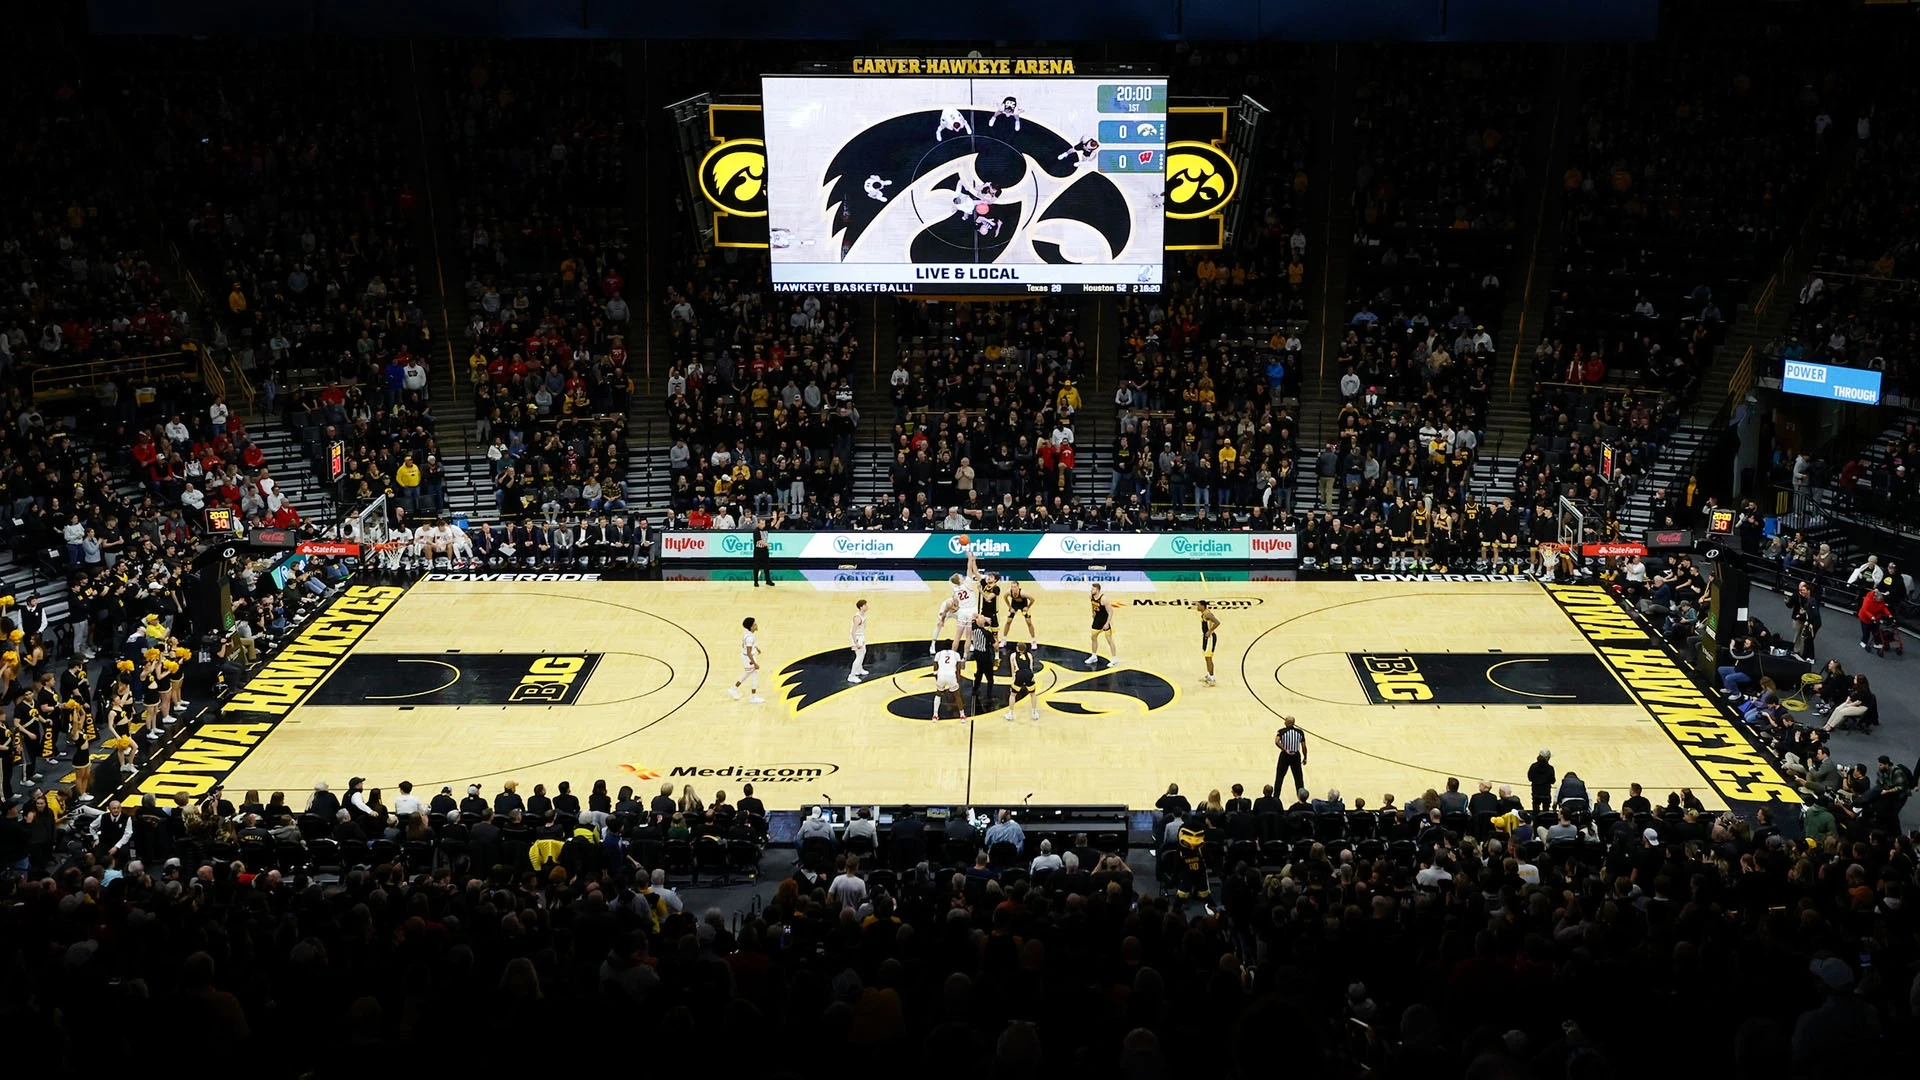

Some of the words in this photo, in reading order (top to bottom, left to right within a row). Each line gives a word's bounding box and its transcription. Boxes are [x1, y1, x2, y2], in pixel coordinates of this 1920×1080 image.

[852, 58, 1010, 74] CARVER-HAWKEYE
[1014, 59, 1075, 75] ARENA
[1116, 86, 1152, 101] 20:00
[1128, 104, 1140, 112] 1ST
[1119, 125, 1127, 139] 0
[1119, 154, 1127, 169] 0
[916, 267, 950, 279] LIVE
[954, 268, 965, 279] &
[969, 268, 1019, 280] LOCAL
[773, 283, 830, 292] HAWKEYE
[833, 283, 914, 293] BASKETBALL!
[1026, 284, 1048, 292] Texas
[1083, 284, 1115, 292] Houston
[1786, 364, 1825, 380] POWER
[1833, 385, 1877, 402] THROUGH
[209, 511, 229, 519] 20:00
[214, 519, 228, 529] 30
[1714, 520, 1728, 530] 30
[837, 538, 894, 551] Veridian
[1064, 539, 1121, 552] Veridian
[1174, 539, 1232, 552] Veridian
[422, 573, 602, 582] POWERADE
[1354, 573, 1530, 582] POWERADE
[957, 590, 970, 601] 22
[1545, 583, 1651, 640] IOWA
[944, 655, 951, 664] 2
[120, 722, 273, 808] IOWA
[221, 585, 404, 715] HAWKEYES
[85, 713, 97, 741] IOWA
[1599, 646, 1804, 803] HAWKEYES
[41, 727, 54, 758] IOWA
[669, 765, 822, 777] Mediacom
